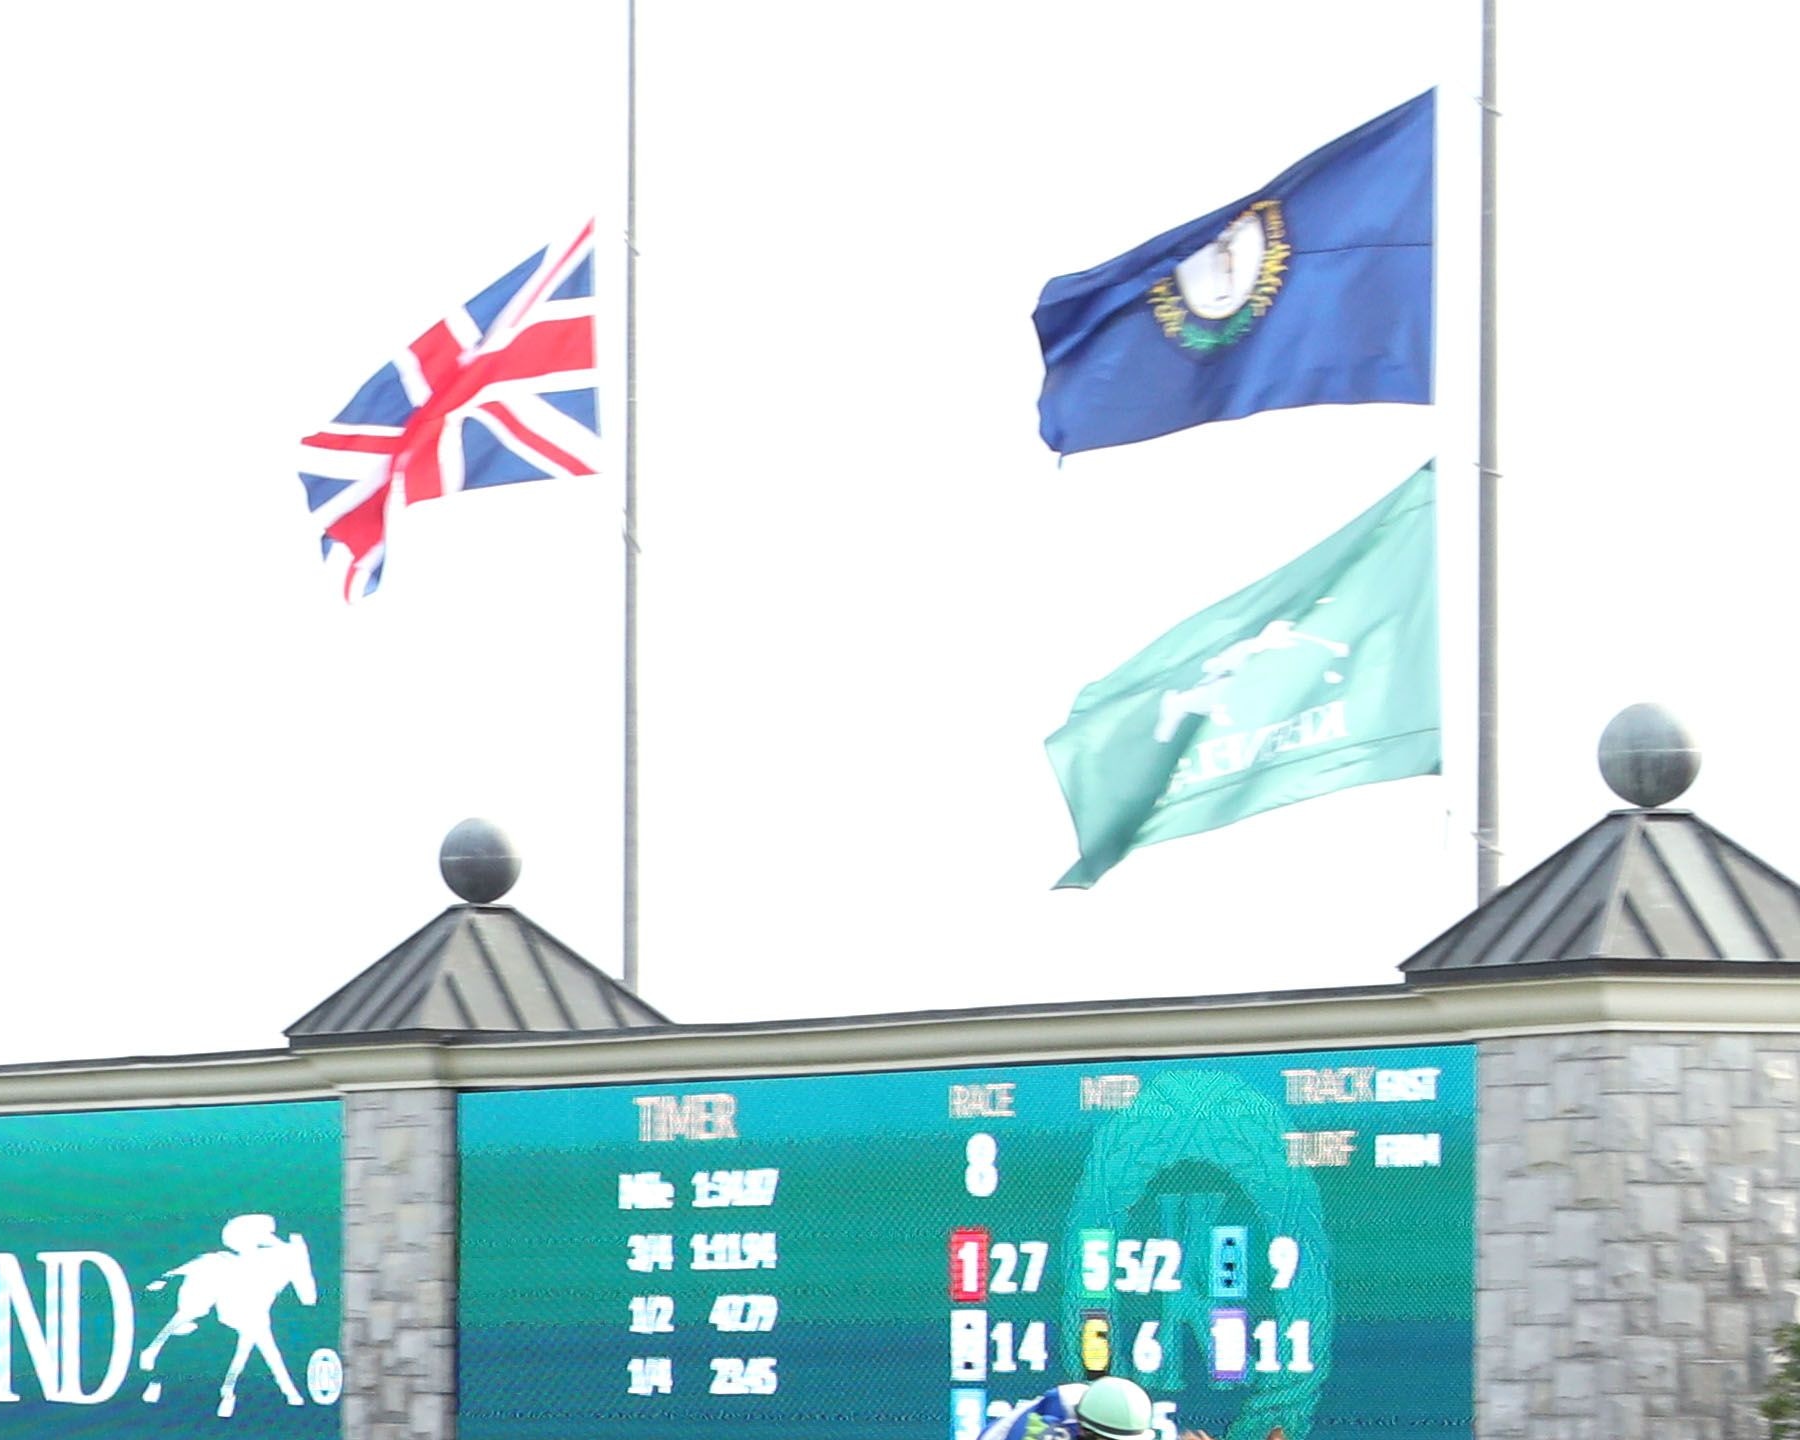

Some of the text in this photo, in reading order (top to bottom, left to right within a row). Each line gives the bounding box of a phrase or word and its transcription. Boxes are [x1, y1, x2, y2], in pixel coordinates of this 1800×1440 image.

[949, 1083, 1016, 1118] RACE
[1281, 1067, 1376, 1104] TRACK
[965, 1133, 998, 1197] 8
[958, 1241, 979, 1292] 1
[990, 1241, 1048, 1293] 27
[1082, 1240, 1110, 1292] 5
[1115, 1238, 1182, 1293] 5/2
[1268, 1236, 1300, 1289] 9
[991, 1321, 1048, 1372] 14
[1132, 1321, 1162, 1373] 6
[1252, 1319, 1314, 1373] 11
